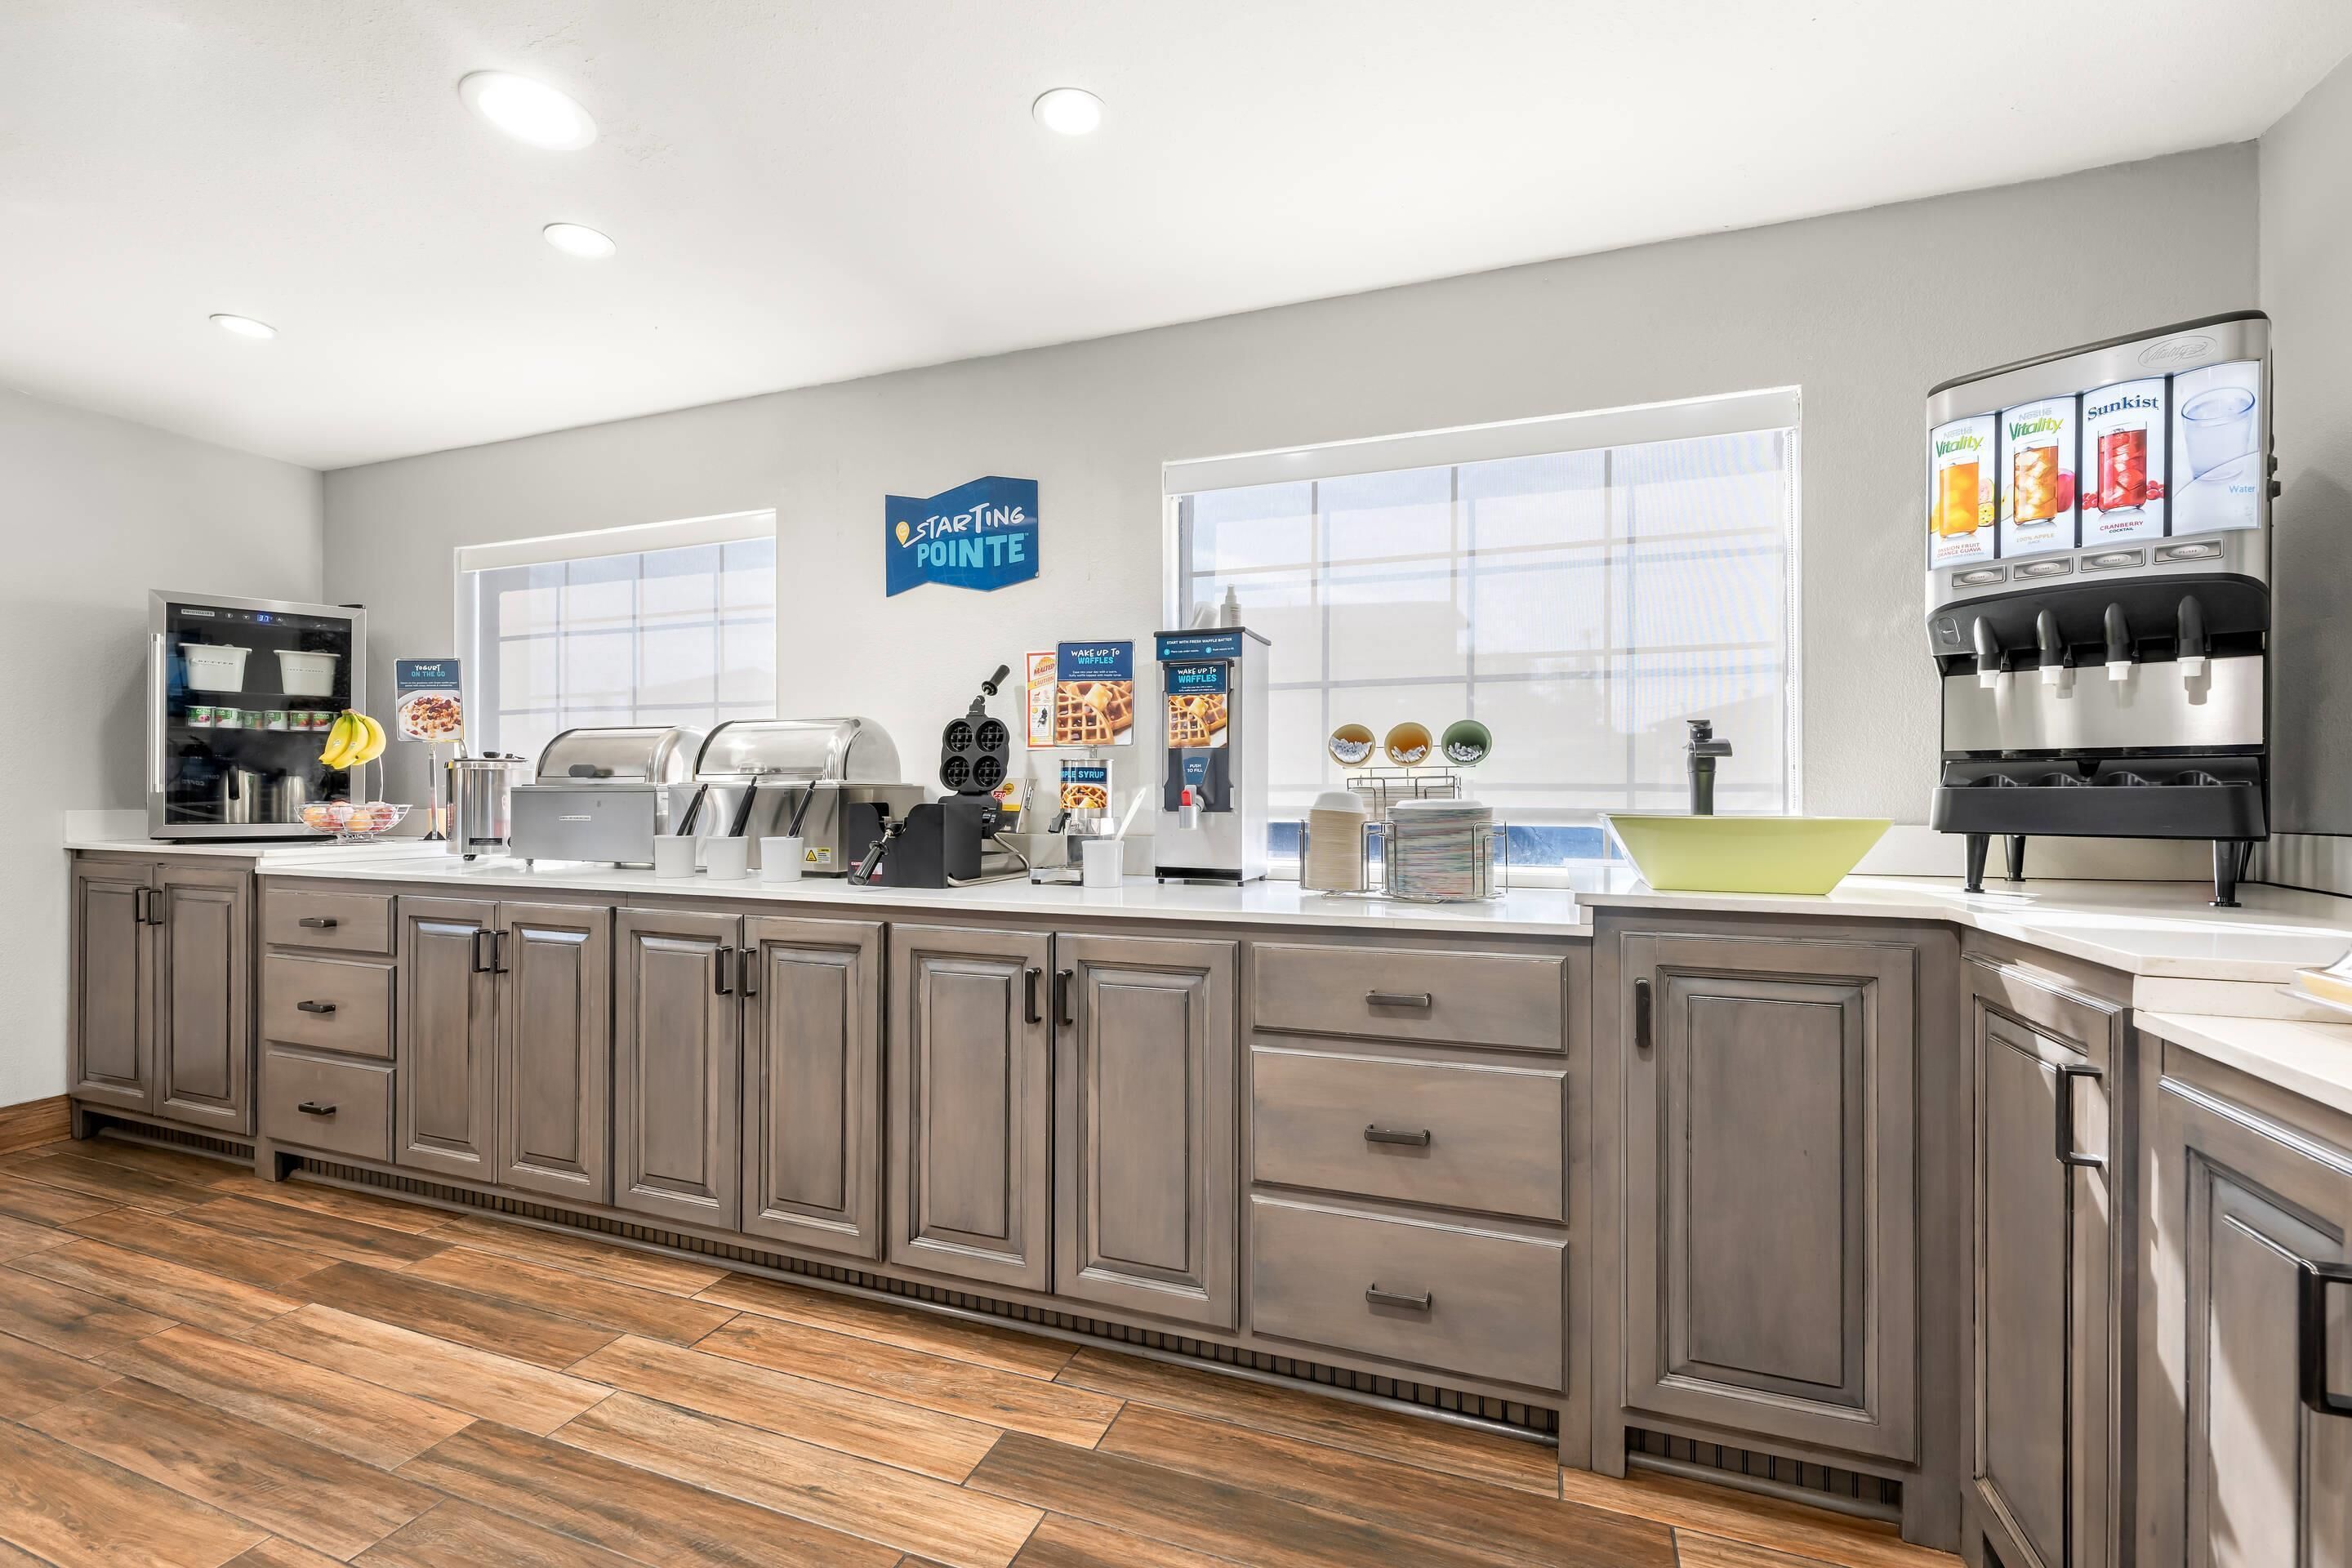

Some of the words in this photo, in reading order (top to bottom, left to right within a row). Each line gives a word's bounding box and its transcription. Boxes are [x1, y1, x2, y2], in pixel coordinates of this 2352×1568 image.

[2087, 394, 2159, 421] Sunkist
[2009, 416, 2064, 441] Vitality
[1936, 435, 1984, 458] Vitality
[2229, 485, 2255, 493] Water
[902, 502, 1026, 549] STARTING
[2100, 521, 2144, 531] CRANBERRY
[917, 532, 1026, 568] POINTE
[1071, 648, 1094, 657] WAKE
[1078, 657, 1114, 665] WAFFLES
[1178, 675, 1217, 684] WAFFLES
[1079, 770, 1105, 778] SYRUP
